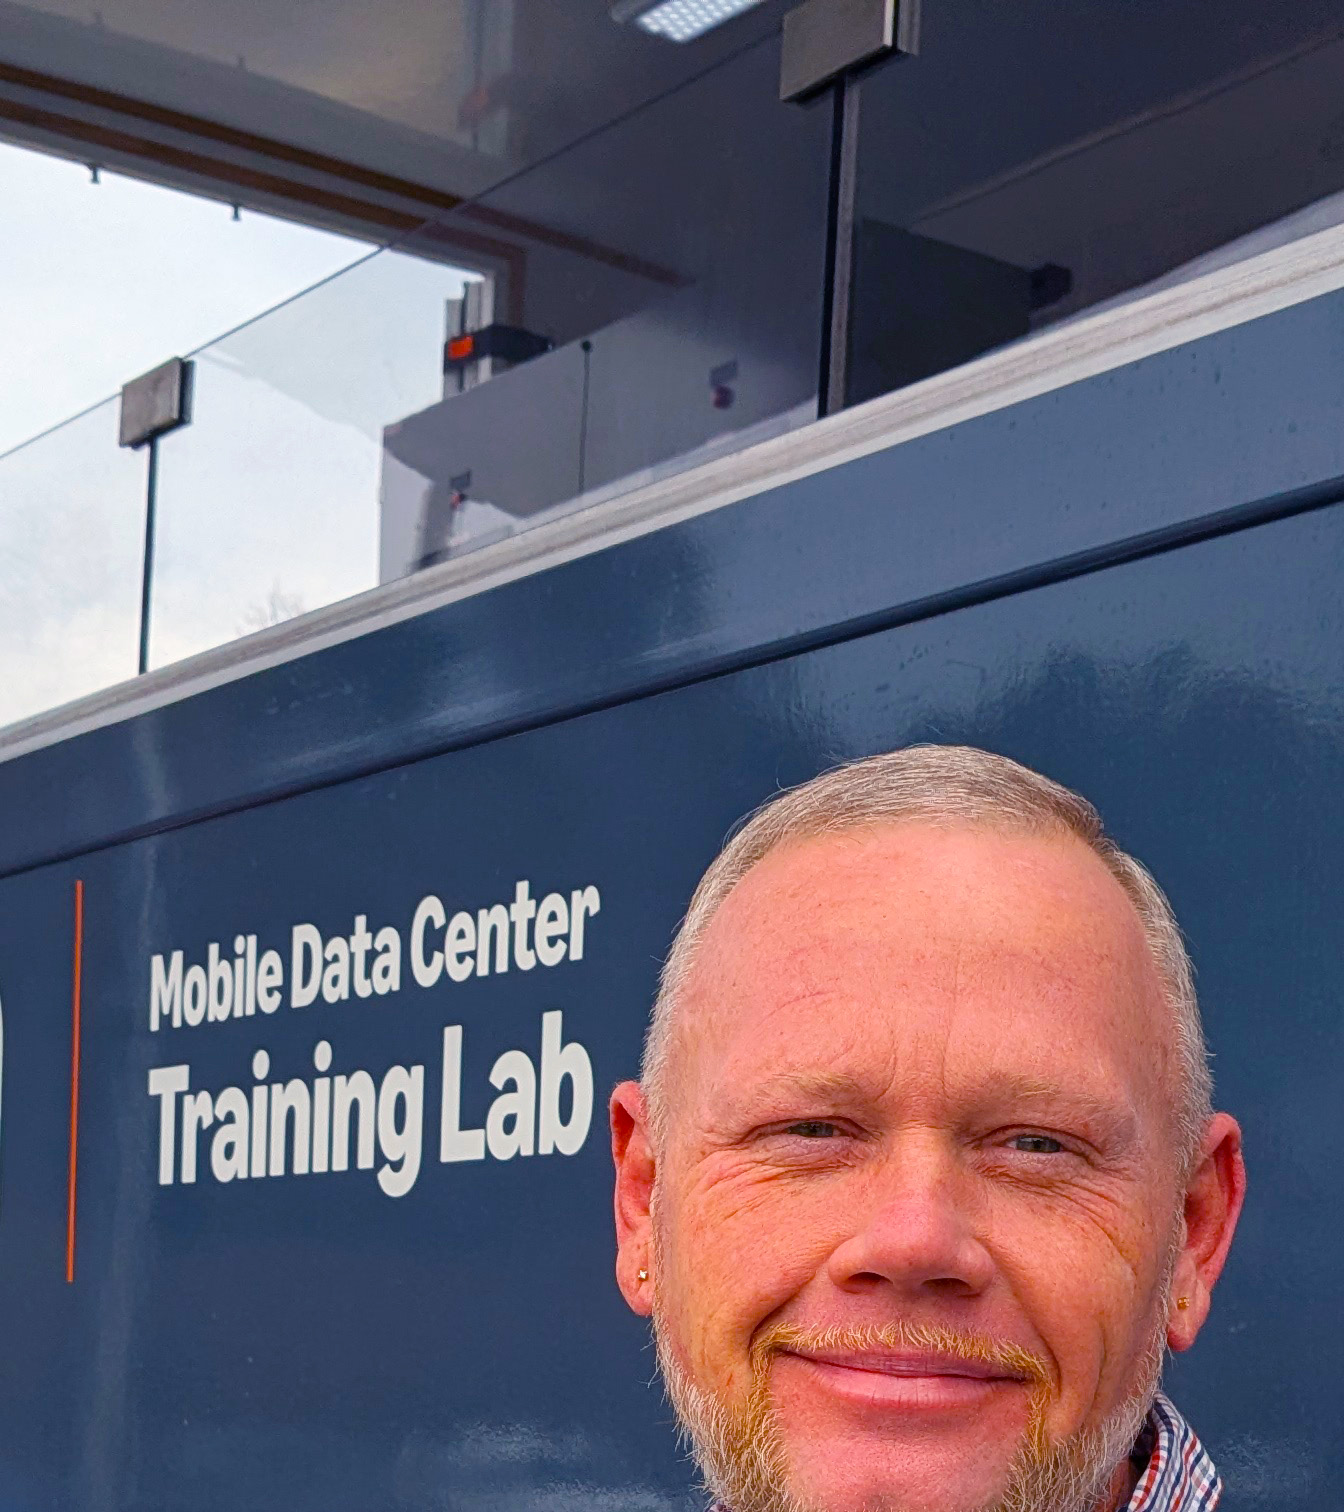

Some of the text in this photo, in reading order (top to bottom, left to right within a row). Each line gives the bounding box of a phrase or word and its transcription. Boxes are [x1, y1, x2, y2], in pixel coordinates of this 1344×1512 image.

[150, 880, 602, 1032] Mobile Data Center
[148, 1010, 595, 1199] Training Lab
